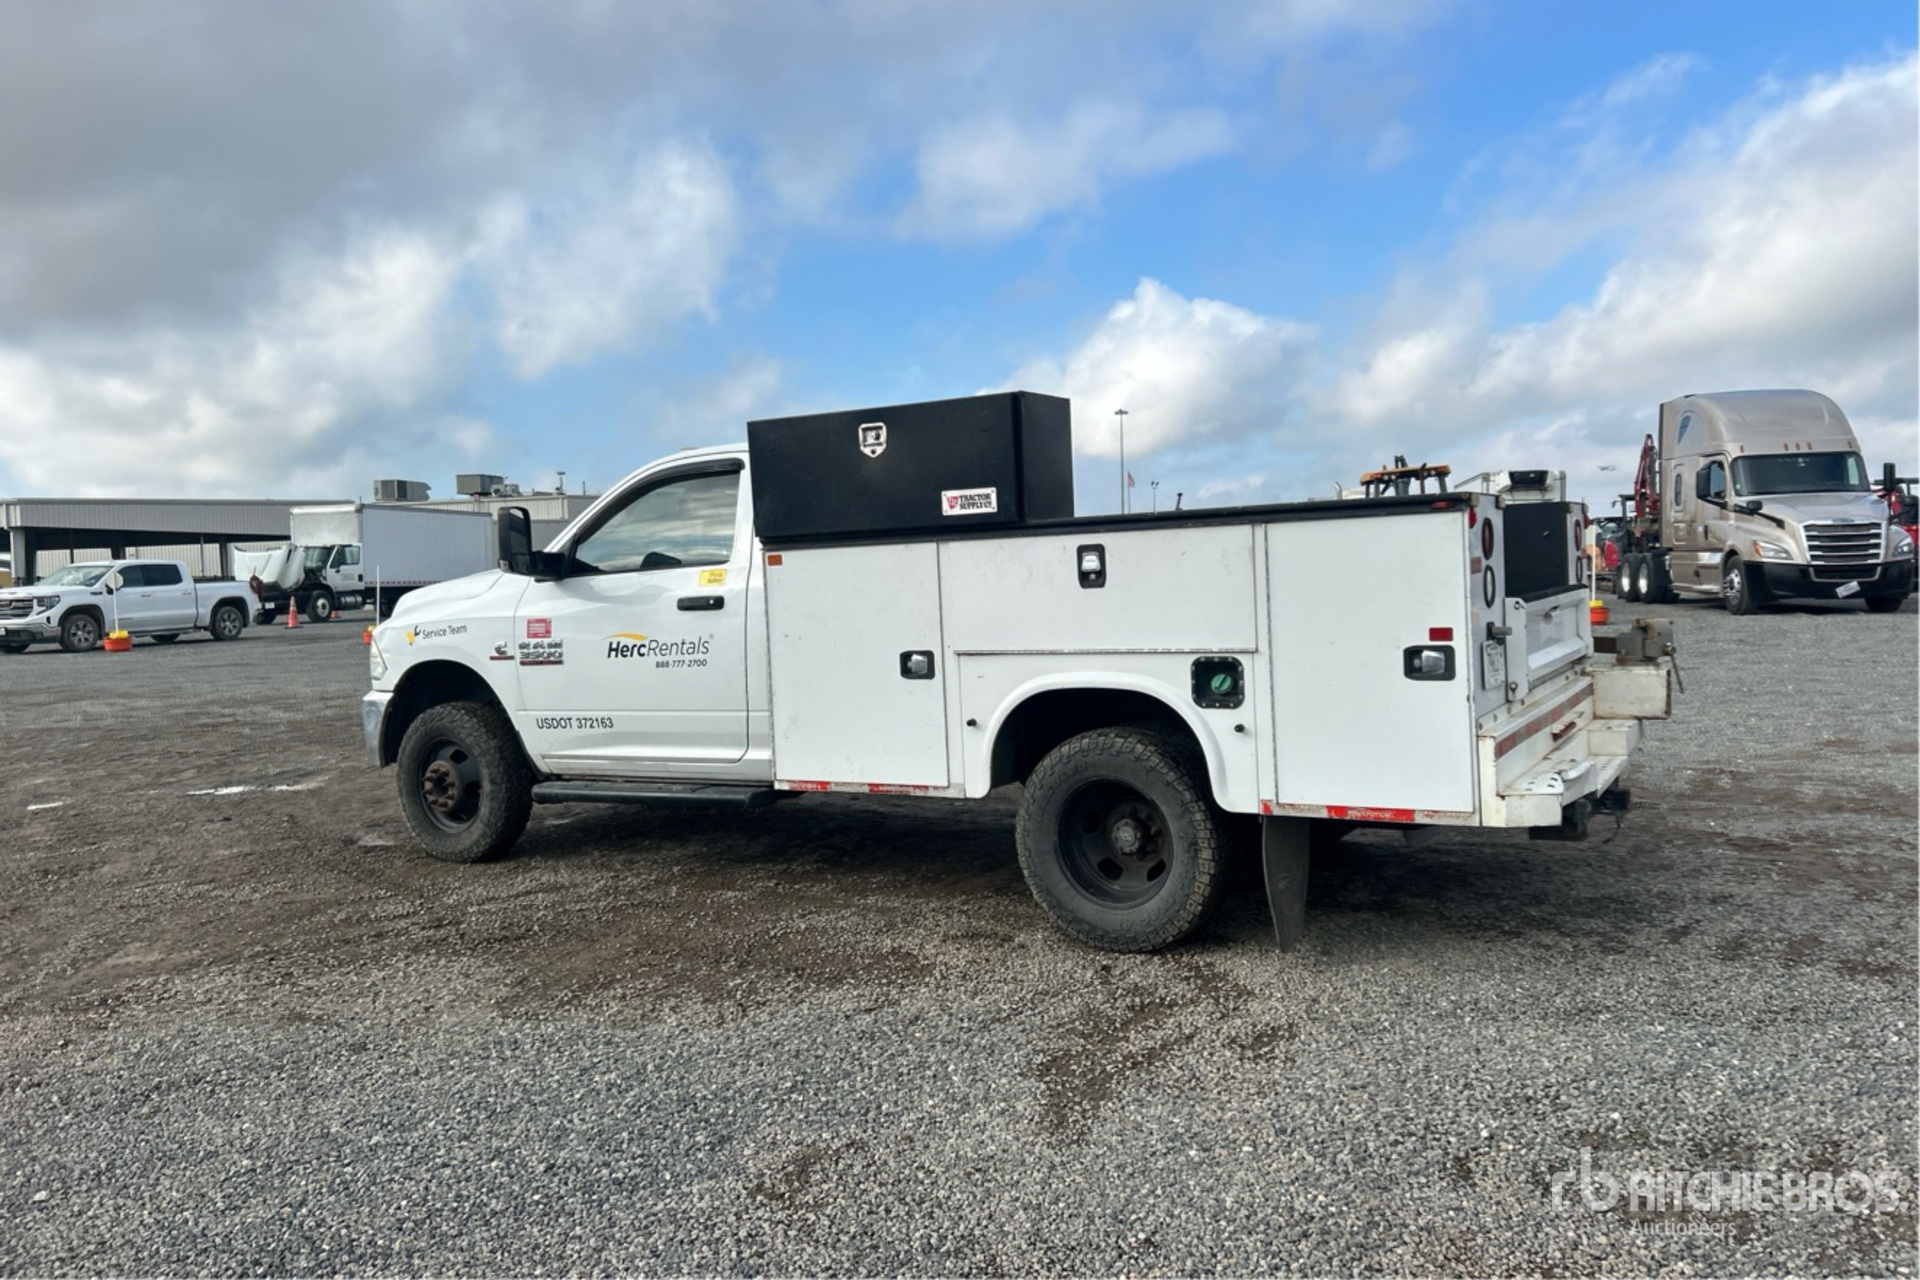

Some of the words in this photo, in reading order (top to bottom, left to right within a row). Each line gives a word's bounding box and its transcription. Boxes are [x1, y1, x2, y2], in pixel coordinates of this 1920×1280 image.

[959, 493, 992, 503] TRACTOR
[422, 628, 447, 640] Service
[447, 624, 468, 635] Team
[536, 717, 573, 729] USDOT
[575, 716, 614, 729] 372163
